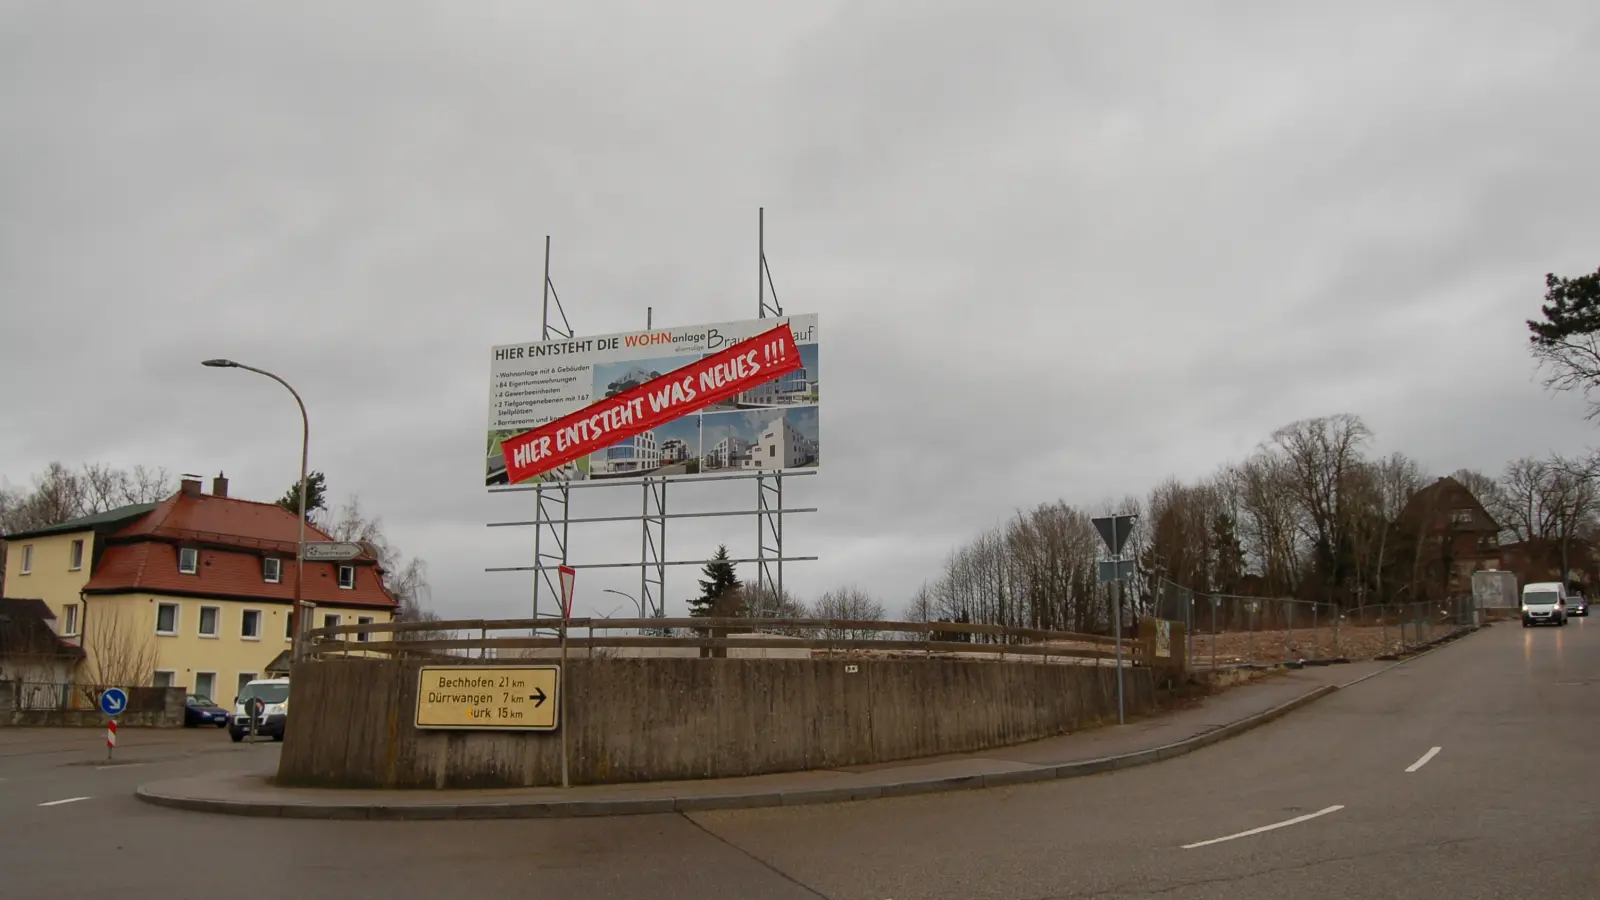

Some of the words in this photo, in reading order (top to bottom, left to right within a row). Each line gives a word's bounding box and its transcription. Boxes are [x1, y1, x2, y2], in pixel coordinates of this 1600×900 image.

[495, 347, 524, 361] HIER
[528, 340, 593, 357] ENTSTEHT
[597, 337, 619, 351] DIE
[624, 331, 706, 348] WOHNanlage
[500, 369, 538, 378] Wohnanlage
[557, 365, 590, 373] Gebäuden
[508, 376, 577, 388] Eigentumswohnungen
[504, 388, 560, 397] Gewerbeeinheiten
[504, 398, 563, 408] Tiefgaragenebenen
[513, 435, 553, 469] HIER
[556, 396, 645, 456] ENTSTEHT
[647, 376, 697, 413] WAS
[699, 350, 761, 394] NEUES
[763, 338, 786, 367] !!!
[498, 408, 533, 416] Stellplätzen
[497, 418, 534, 426] Barrierearm
[438, 677, 494, 688] Bechhofen
[498, 677, 509, 687] 21
[428, 692, 493, 705] Dürrwangen
[503, 692, 509, 703] 7
[511, 695, 524, 703] km
[468, 707, 491, 718] urk
[498, 707, 508, 718] 15
[510, 710, 523, 718] km
